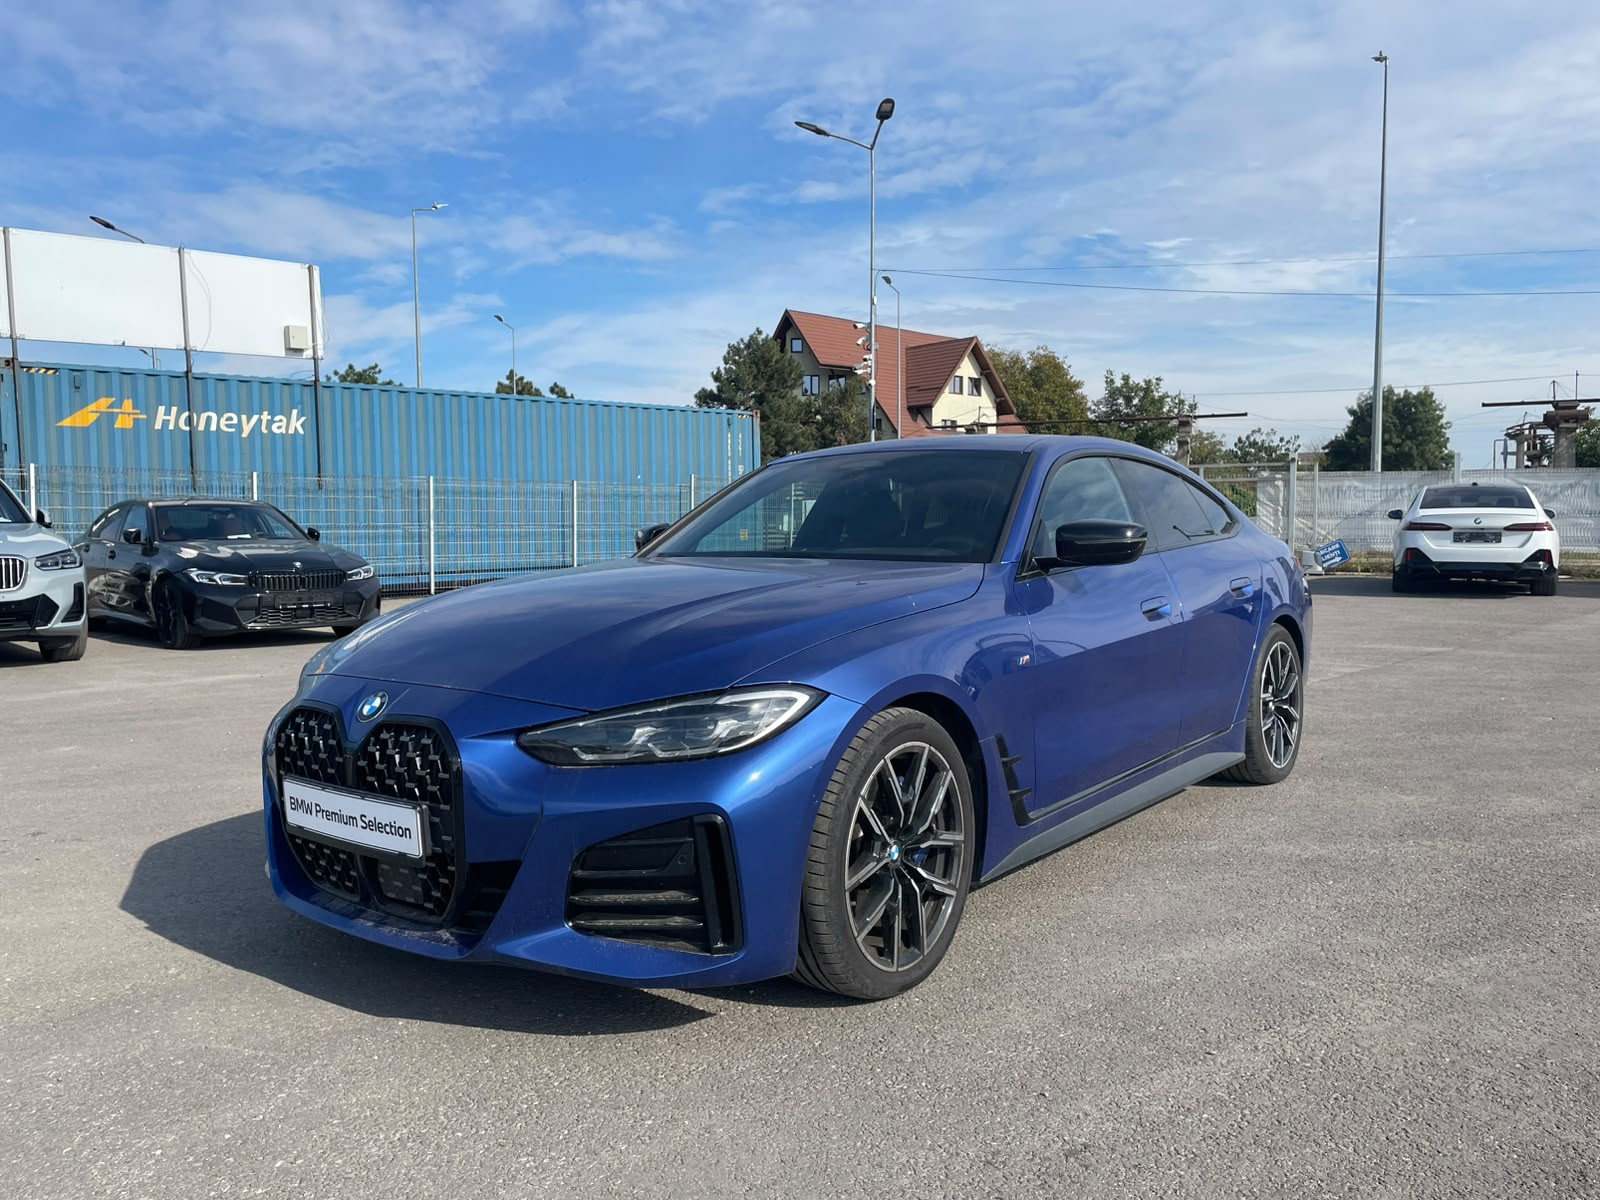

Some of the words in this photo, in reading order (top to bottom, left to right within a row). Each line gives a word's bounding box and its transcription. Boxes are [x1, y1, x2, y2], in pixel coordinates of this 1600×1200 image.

[154, 405, 306, 438] Honeytak
[289, 796, 312, 816] BMW
[315, 802, 358, 827] Premium
[360, 814, 412, 839] Selection
